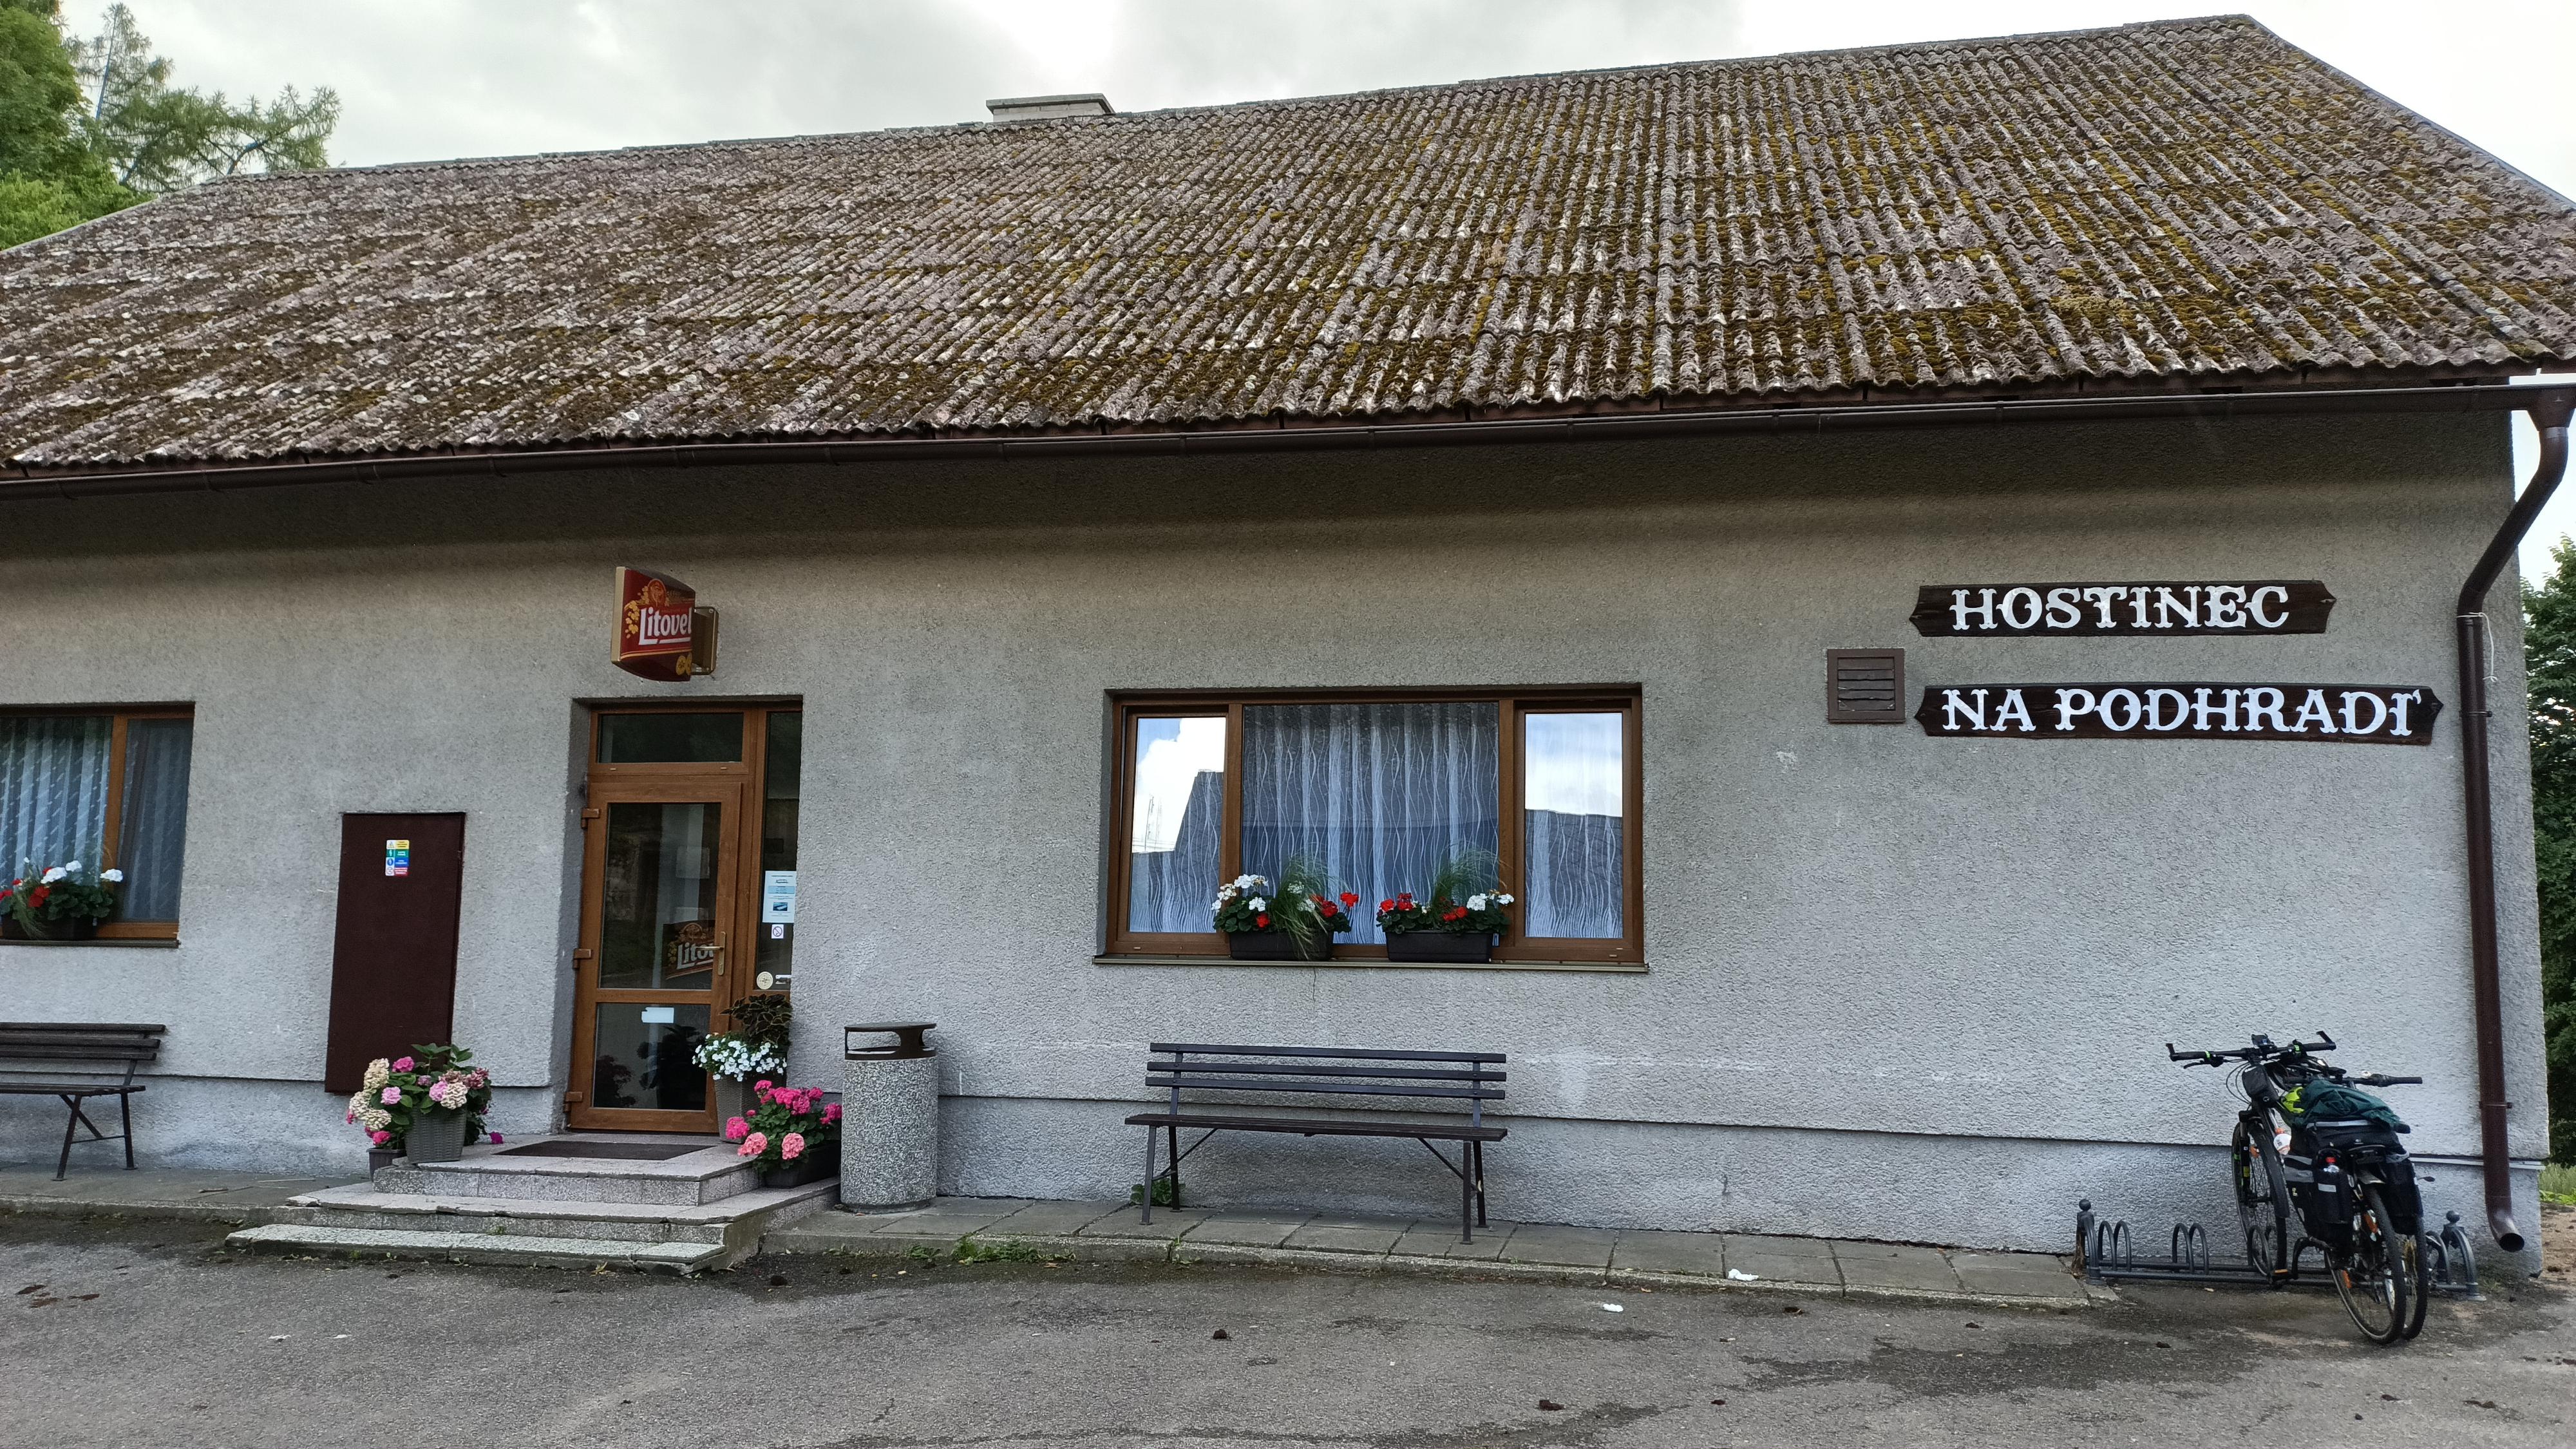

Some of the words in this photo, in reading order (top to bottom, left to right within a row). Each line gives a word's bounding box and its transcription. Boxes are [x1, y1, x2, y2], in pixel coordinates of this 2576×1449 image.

[638, 606, 692, 645] Litovel
[1949, 585, 2289, 630] HOSTINEC
[1941, 688, 2036, 732] NA
